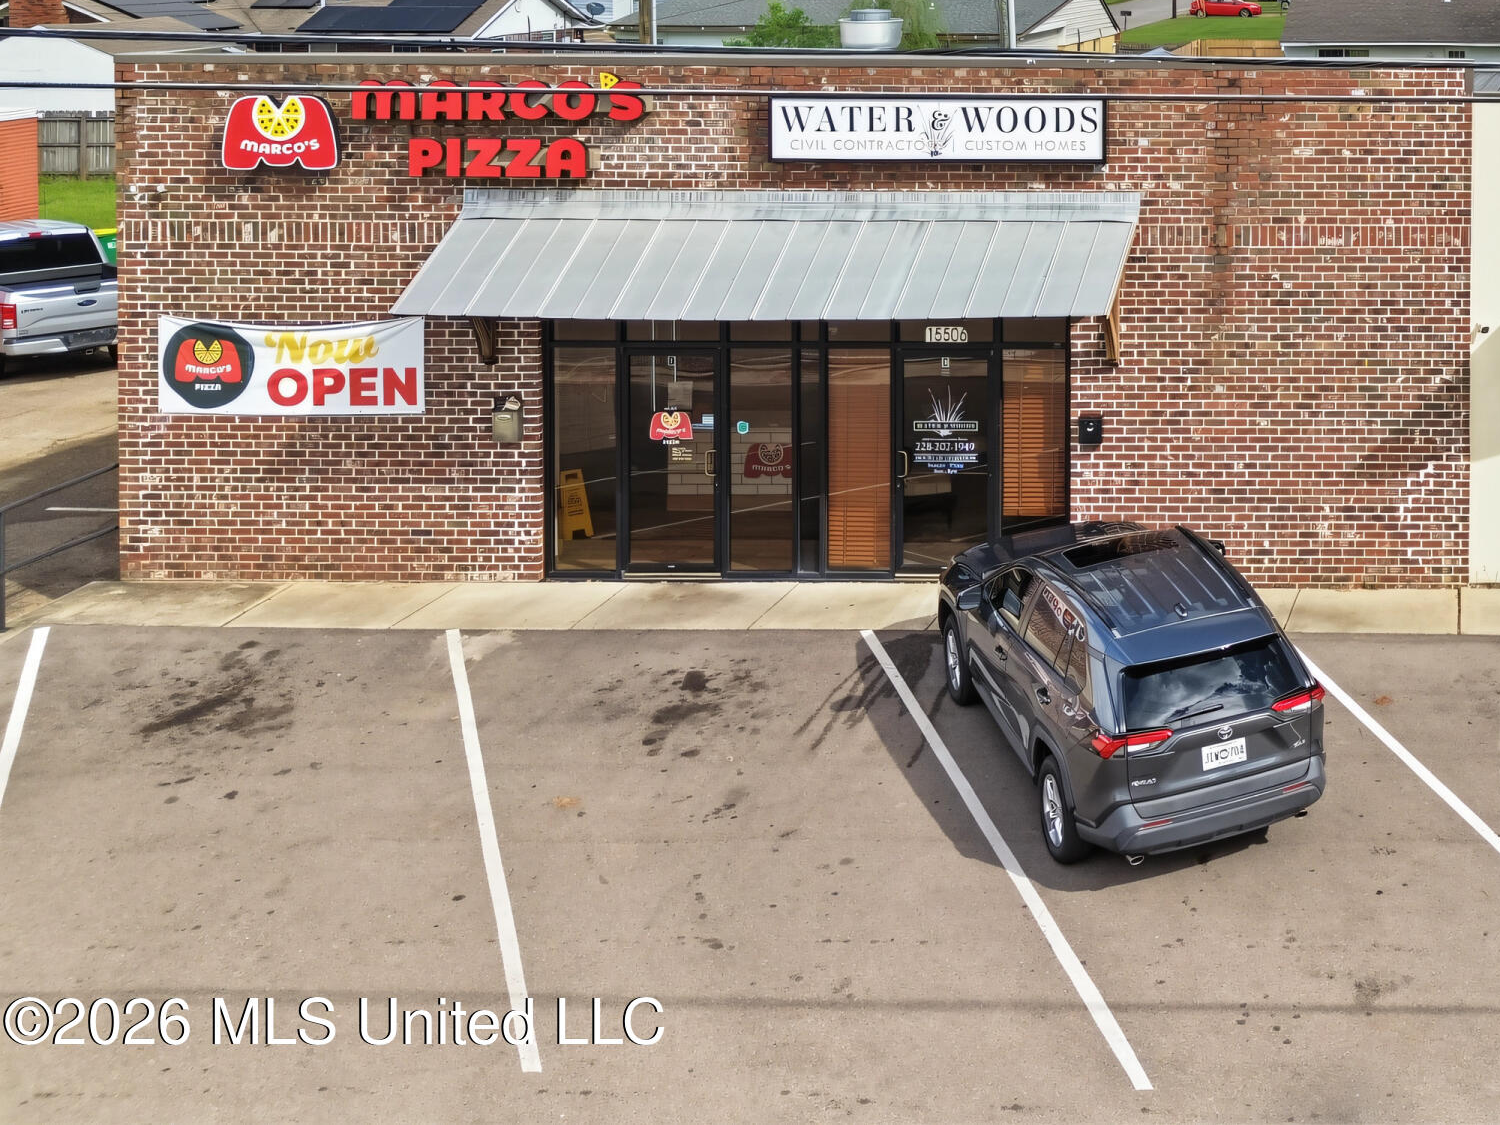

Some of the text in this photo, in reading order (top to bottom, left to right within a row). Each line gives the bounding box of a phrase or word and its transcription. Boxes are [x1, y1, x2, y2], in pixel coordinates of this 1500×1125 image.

[352, 73, 644, 121] MARCO'S
[779, 105, 1098, 133] WATER & WOODS
[240, 139, 320, 155] MARCO'S
[408, 138, 586, 178] PIZZA
[790, 139, 827, 151] CIVIL
[964, 140, 1027, 151] CUSTOM
[1034, 140, 1086, 151] HOMES
[264, 331, 380, 365] Now
[928, 327, 968, 342] 15506
[267, 367, 418, 406] OPEN
